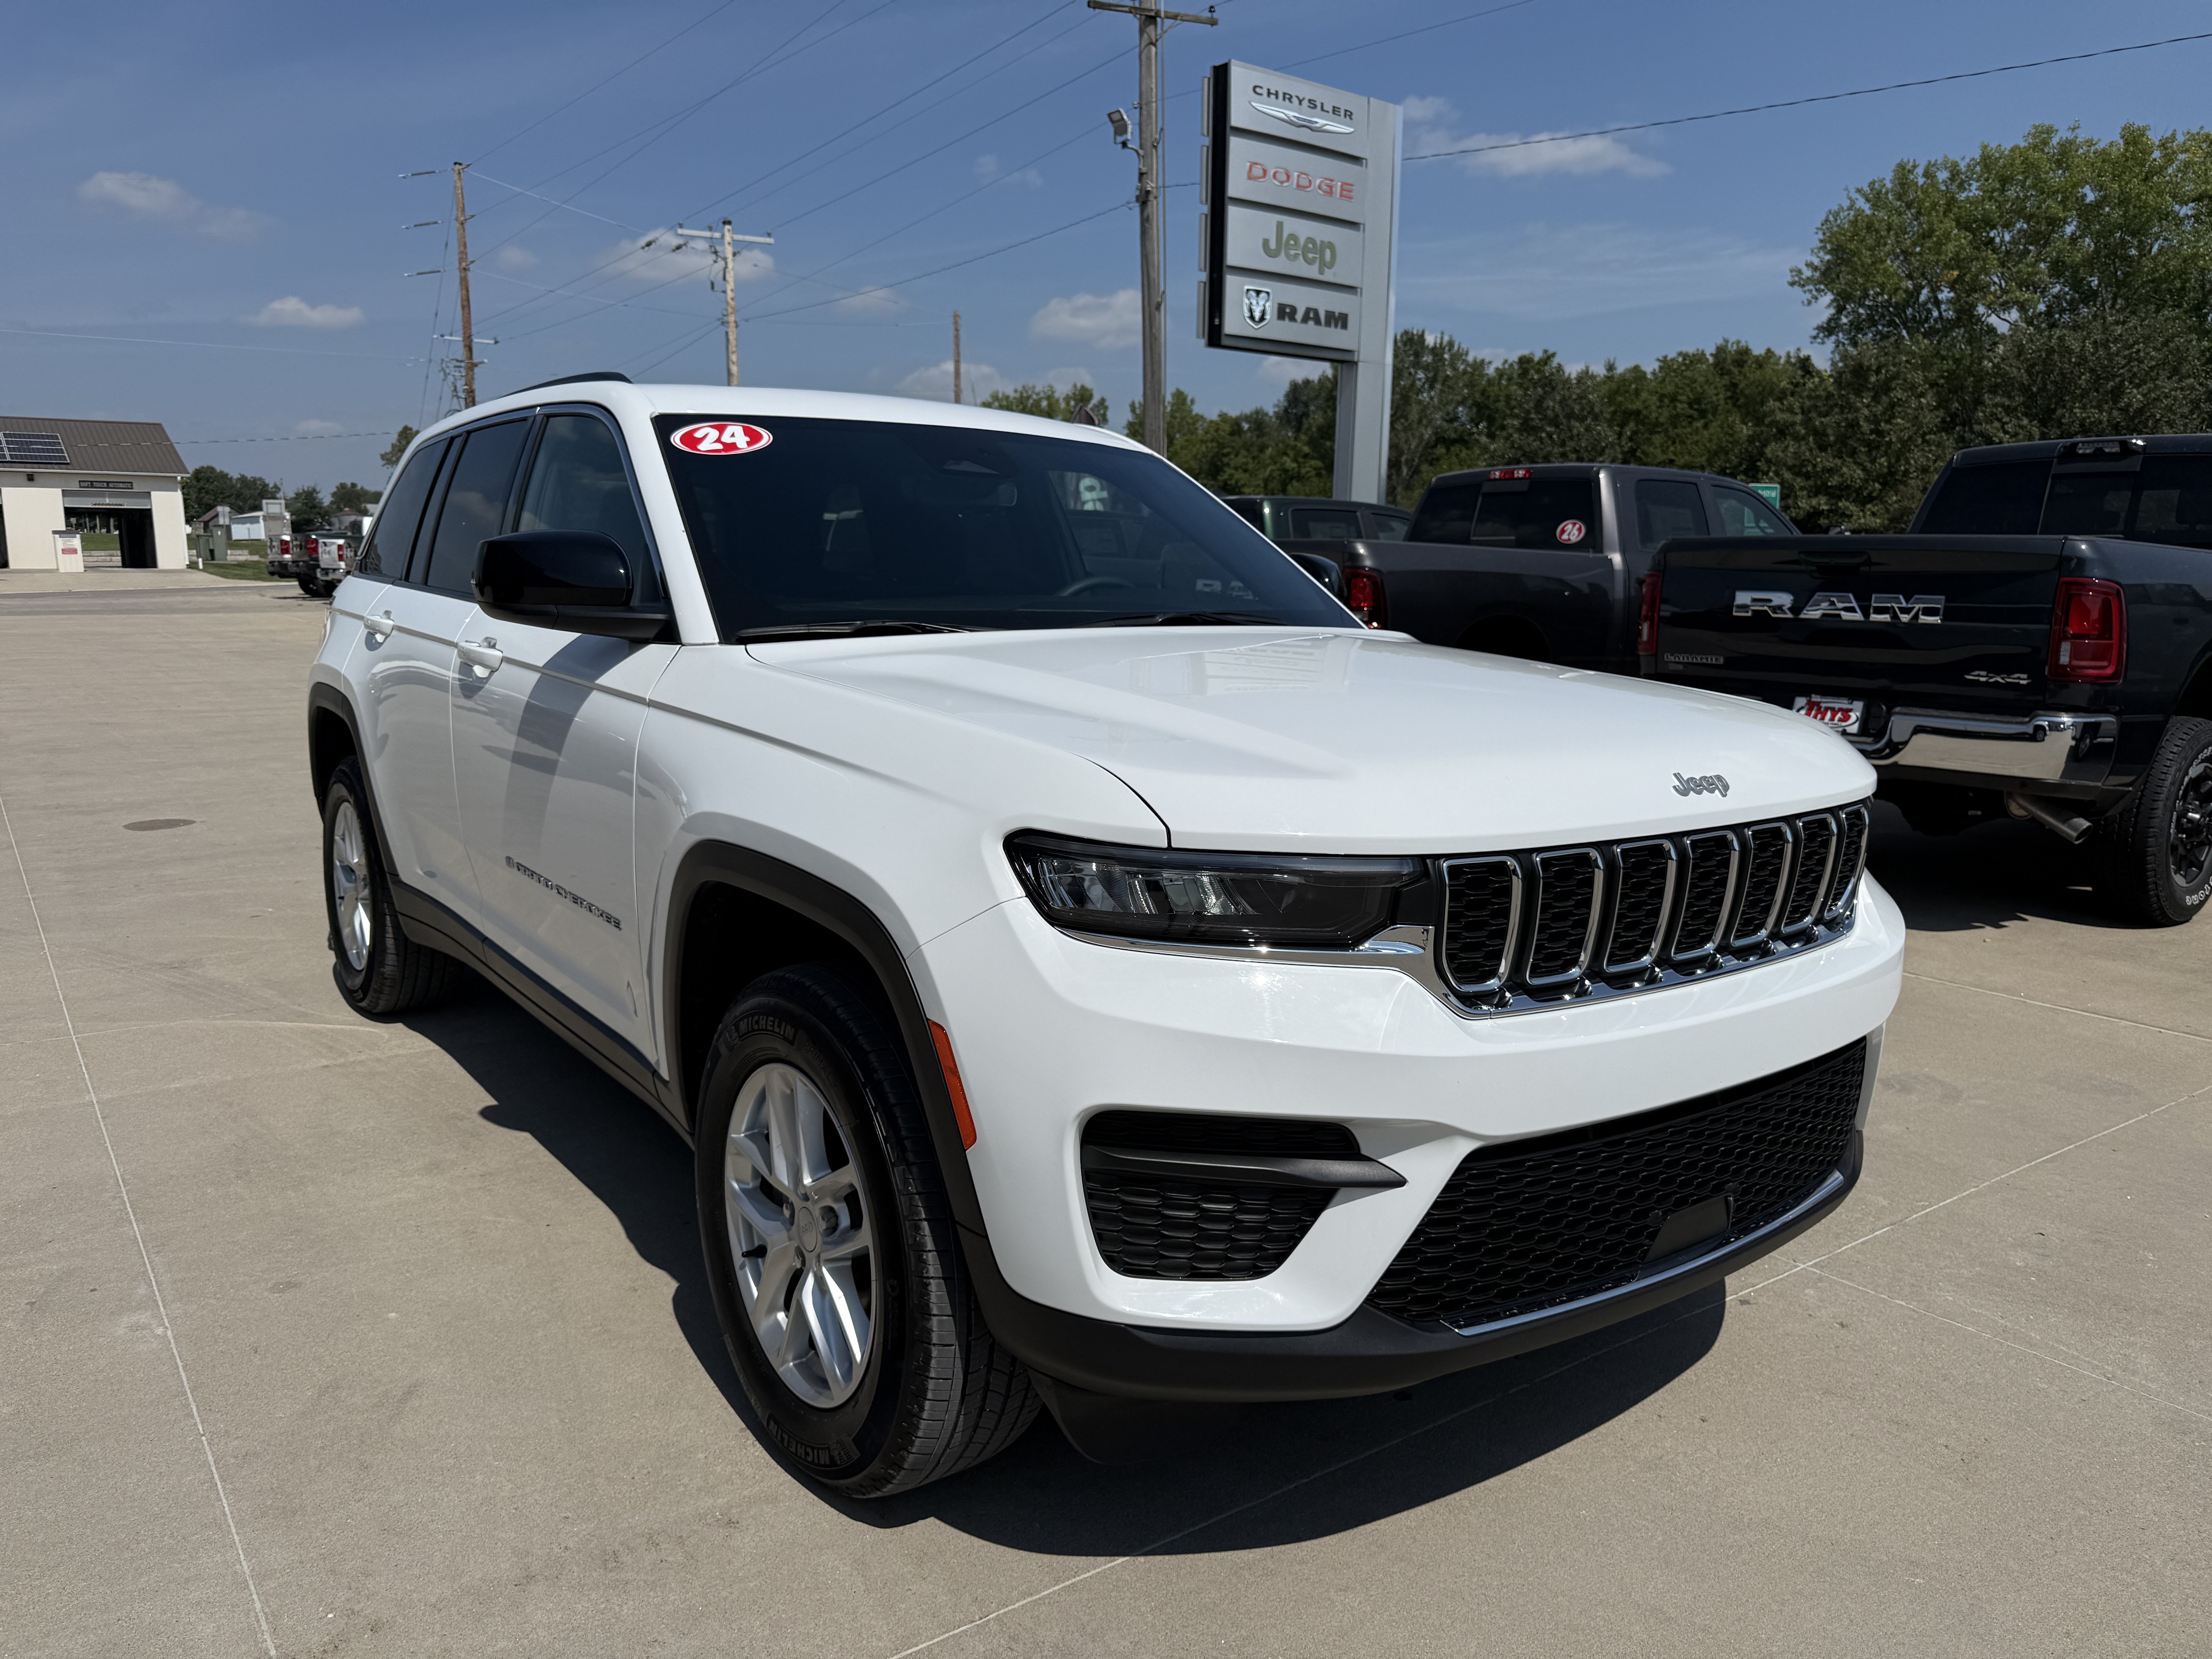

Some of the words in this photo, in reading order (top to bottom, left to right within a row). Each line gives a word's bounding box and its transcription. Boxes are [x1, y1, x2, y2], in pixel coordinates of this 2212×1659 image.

[1252, 84, 1354, 121] CHRYSLER
[1247, 161, 1355, 201] DODGE
[1262, 221, 1337, 275] Jeep
[1276, 302, 1348, 331] RAM
[693, 426, 750, 451] 24
[1561, 524, 1580, 541] 26
[1733, 590, 1945, 624] RAM
[1664, 653, 1724, 665] LARAMIE
[1805, 700, 1853, 723] THYS
[1671, 772, 1730, 798] Jeep
[515, 862, 553, 890] GRAND
[555, 884, 623, 931] CHEROKEE
[739, 1015, 795, 1040] MICHELIN
[769, 1419, 830, 1464] MICHELIN
